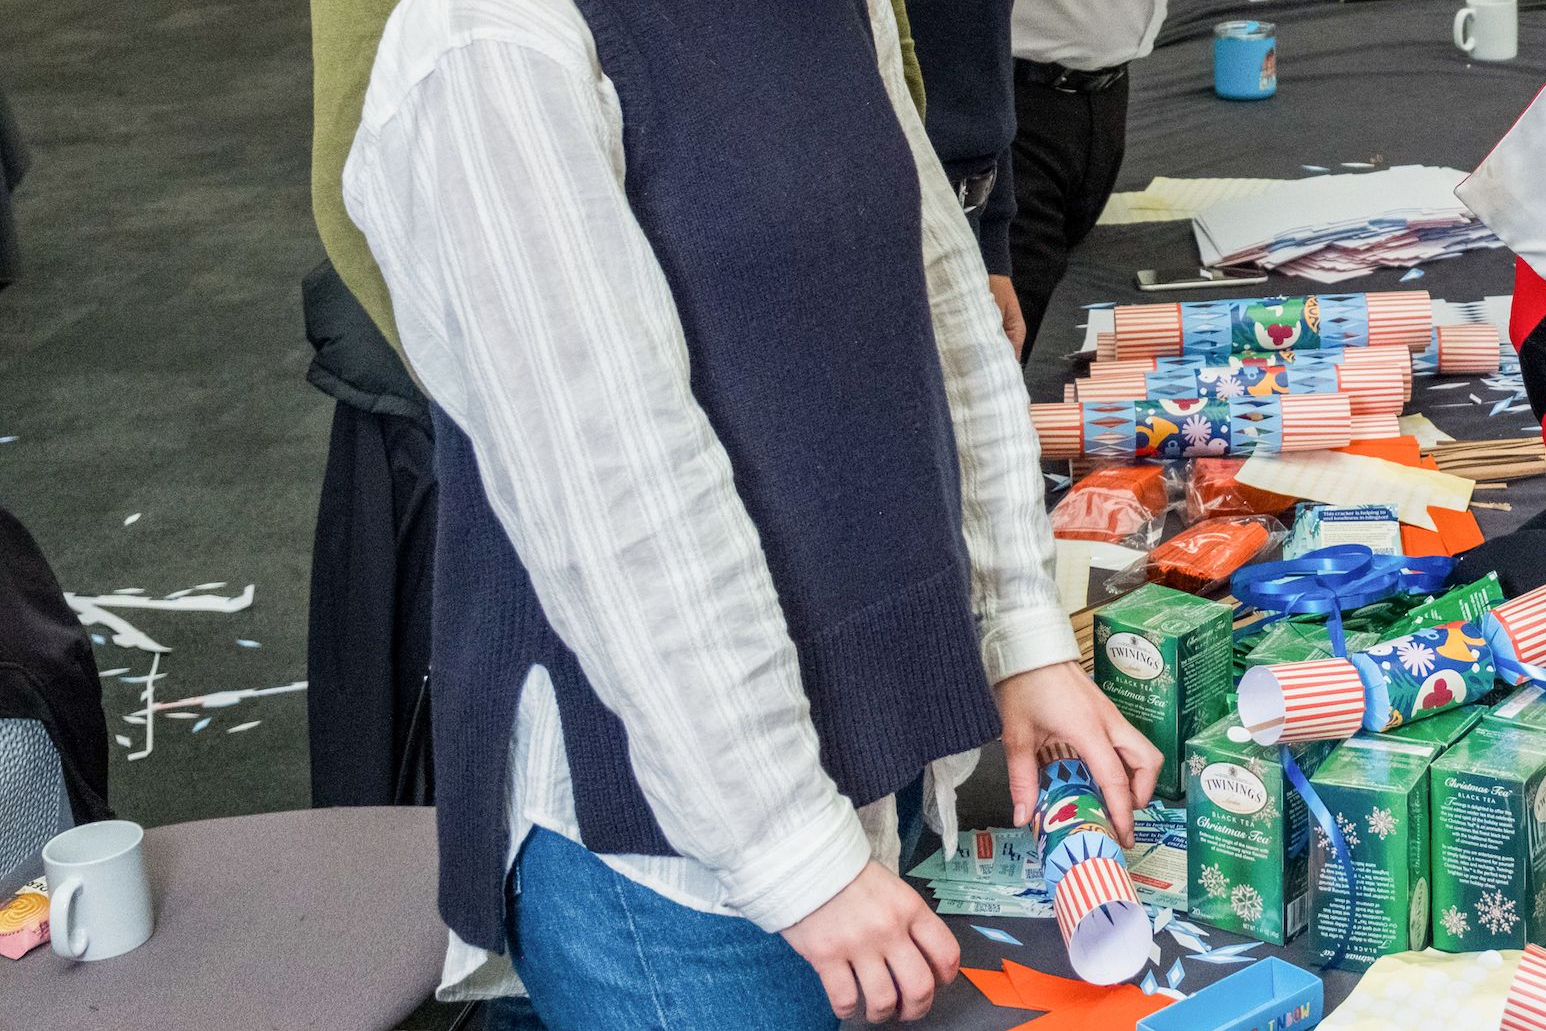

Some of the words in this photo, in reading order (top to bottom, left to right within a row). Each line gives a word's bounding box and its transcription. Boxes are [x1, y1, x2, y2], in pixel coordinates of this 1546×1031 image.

[1109, 645, 1160, 671] TWININGS
[1102, 680, 1147, 703] Christmas
[1115, 676, 1138, 688] BLACK
[1140, 682, 1154, 692] TEA
[1205, 778, 1263, 803] TWININGS
[1444, 777, 1490, 794] Christmas
[1457, 792, 1480, 801] BLACK
[1482, 796, 1496, 804] TEA
[1196, 815, 1247, 839] Christmas
[1211, 811, 1238, 824] BLACK
[1240, 818, 1255, 828] TEA
[1192, 906, 1201, 915] 20
[1344, 953, 1376, 964] istmas
